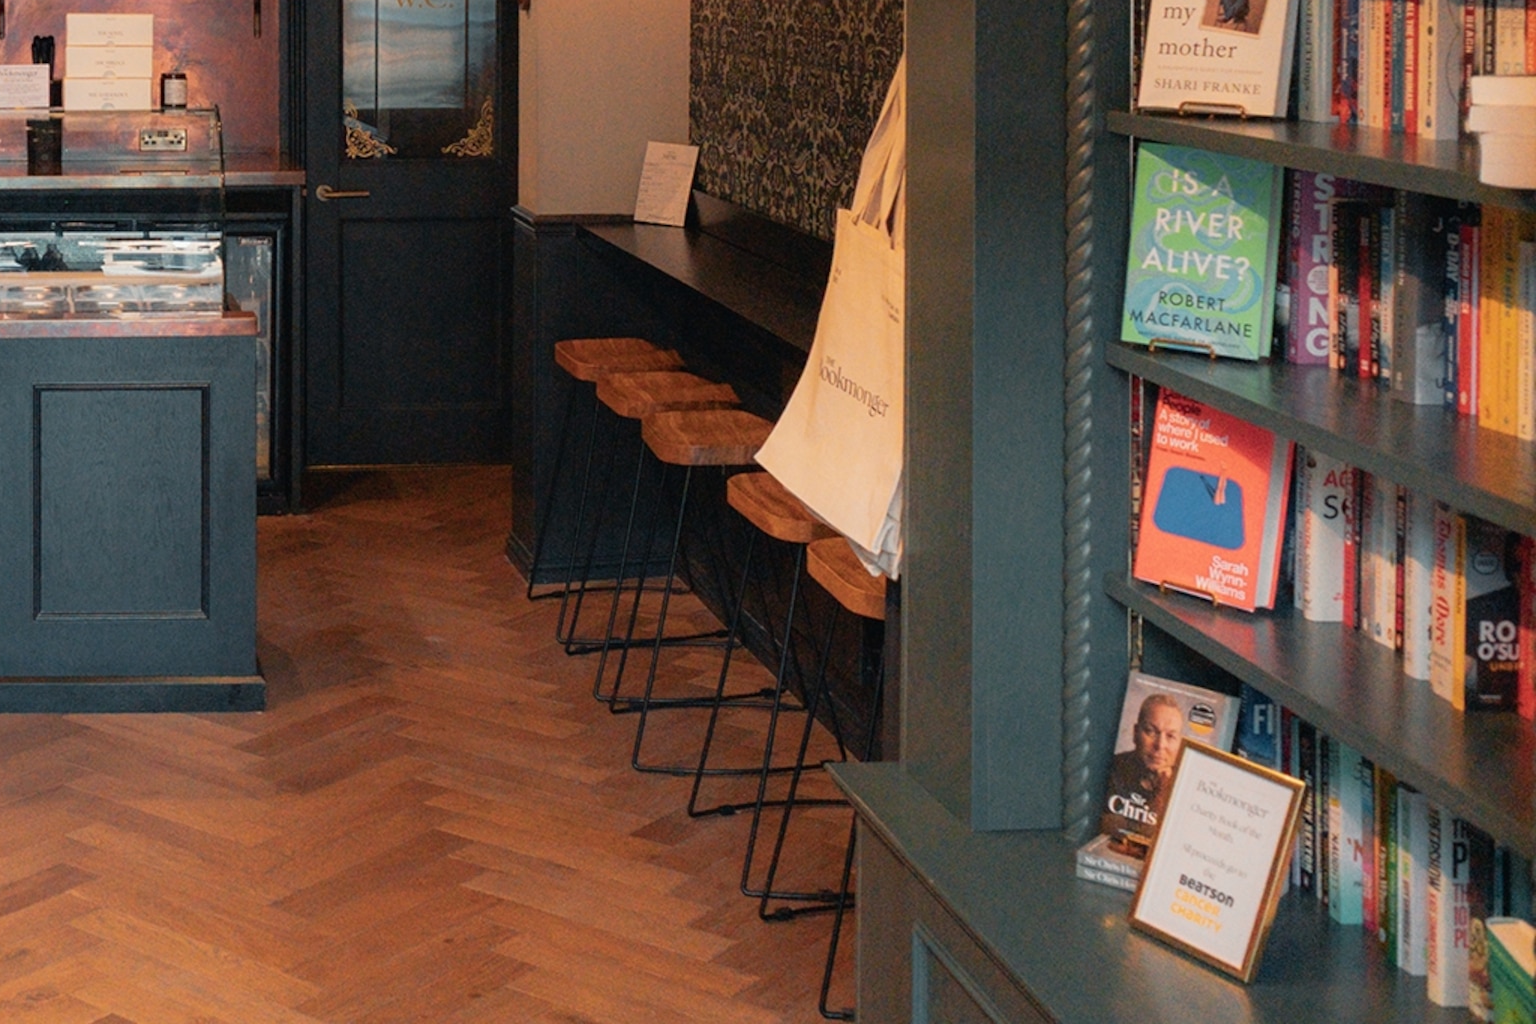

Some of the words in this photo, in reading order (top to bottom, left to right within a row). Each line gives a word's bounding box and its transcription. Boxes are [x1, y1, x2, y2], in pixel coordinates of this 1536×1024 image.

[1163, 5, 1196, 27] my
[1159, 38, 1238, 59] mother
[1154, 78, 1198, 92] SHARI
[1203, 81, 1262, 96] FRANKE
[1172, 168, 1199, 196] IS
[1211, 174, 1234, 198] A
[1155, 207, 1244, 241] RIVER
[1141, 246, 1251, 282] ALIVE?
[1447, 232, 1459, 283] D-DAY
[1158, 289, 1226, 312] ROBERT
[1129, 310, 1253, 340] MACFARLANE
[1159, 408, 1168, 420] A
[1169, 412, 1197, 430] story
[1198, 418, 1211, 430] of
[1156, 432, 1168, 446] to
[1169, 436, 1200, 453] work
[1158, 422, 1193, 439] where
[1200, 431, 1229, 447] used
[1209, 565, 1248, 590] Wynn-
[1212, 554, 1249, 577] Sarah
[1195, 574, 1246, 602] Williams
[1478, 620, 1517, 642] RO
[1107, 794, 1159, 826] Chris
[1131, 791, 1148, 806] Sir
[1196, 780, 1269, 819] Bookmonger
